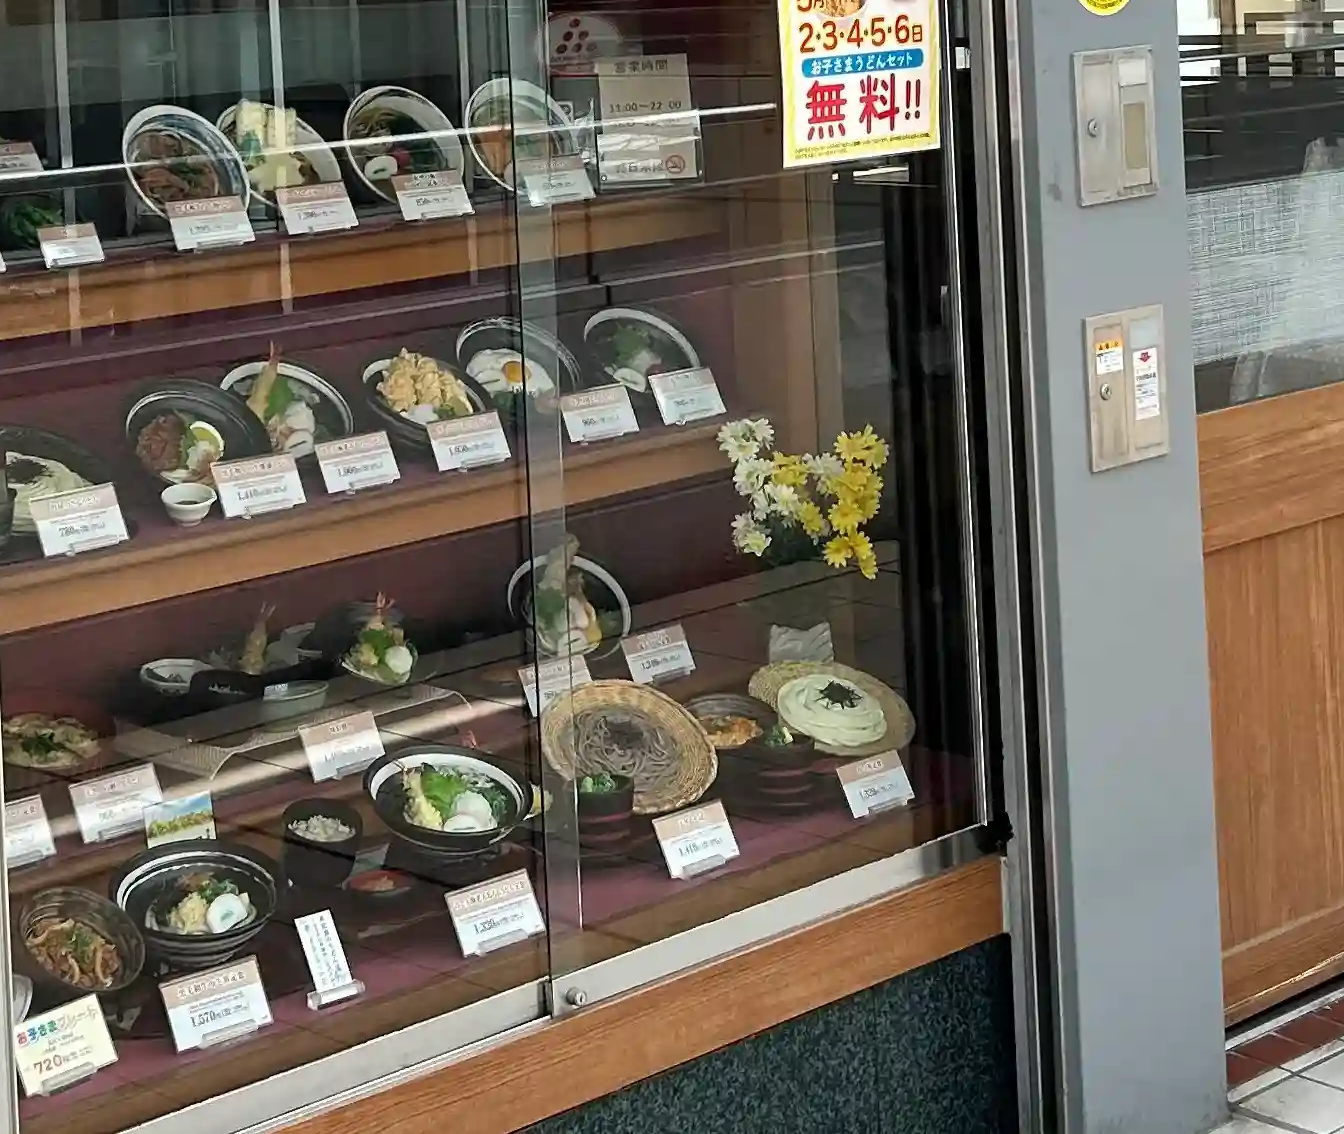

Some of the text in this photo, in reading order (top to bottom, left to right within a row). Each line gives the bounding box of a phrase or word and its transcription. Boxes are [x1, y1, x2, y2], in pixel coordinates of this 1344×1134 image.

[810, 52, 914, 76] お子さまうどんセット
